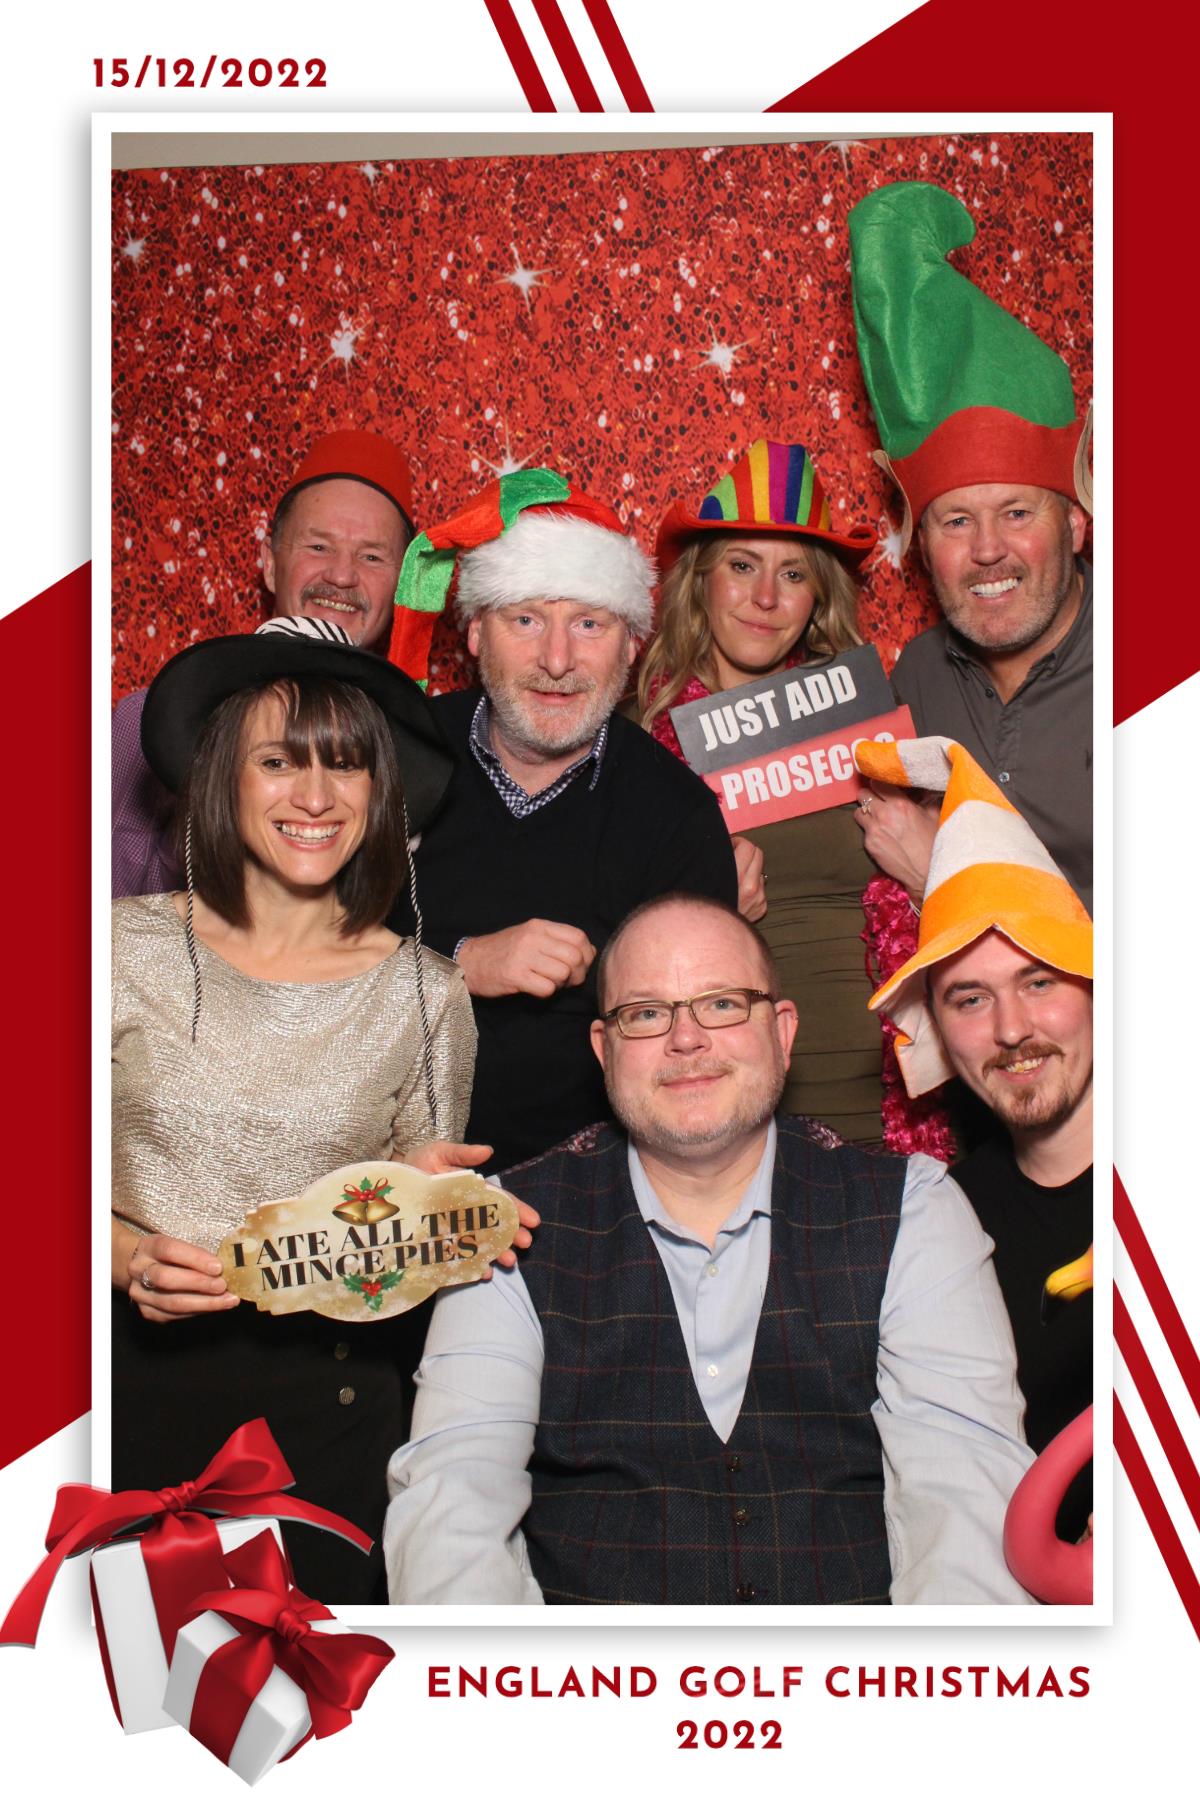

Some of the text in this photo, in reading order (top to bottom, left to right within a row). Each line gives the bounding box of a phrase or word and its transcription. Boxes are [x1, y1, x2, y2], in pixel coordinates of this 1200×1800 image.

[699, 665, 857, 752] JUST ADD
[230, 1204, 500, 1268] I ATE ALL THE
[260, 1235, 479, 1291] MINCE PIES
